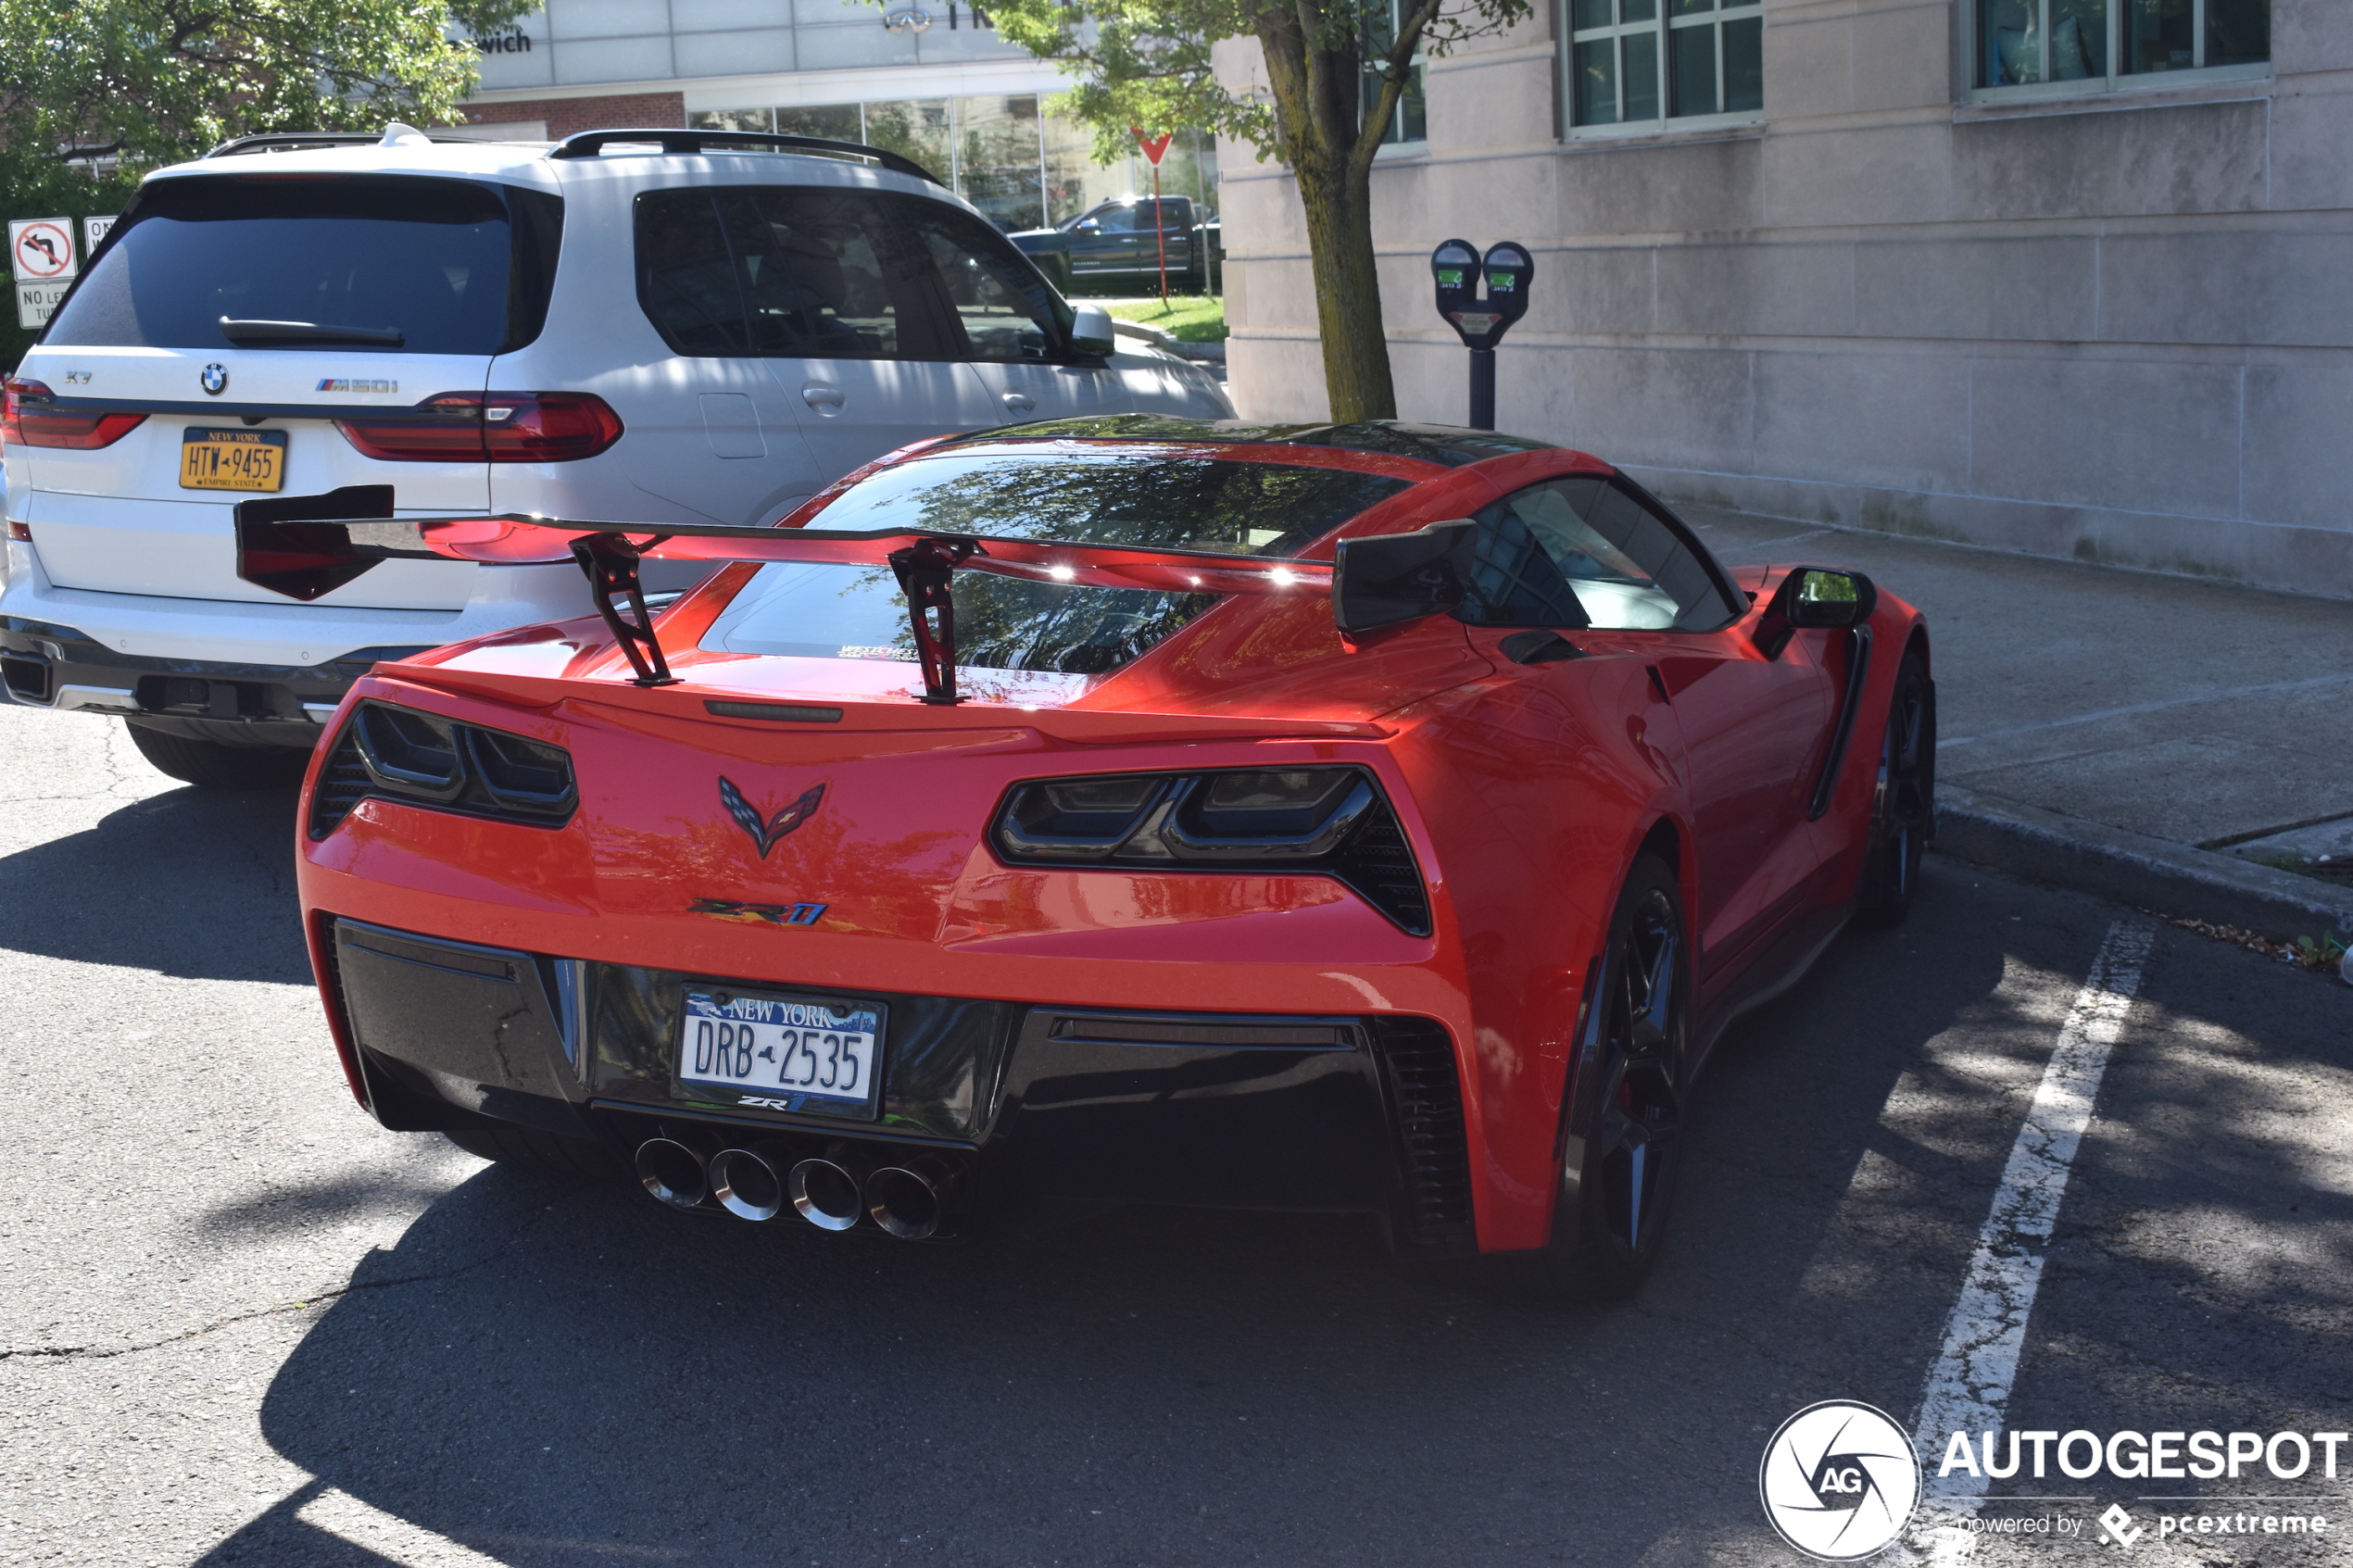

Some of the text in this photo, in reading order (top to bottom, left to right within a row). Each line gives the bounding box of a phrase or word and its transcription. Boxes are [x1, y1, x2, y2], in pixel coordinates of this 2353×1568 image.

[23, 291, 42, 305] NO
[65, 370, 93, 384] X7
[208, 432, 261, 443] NEW YORK
[205, 478, 257, 488] EMPIRE STATE
[686, 898, 828, 925] ZR1
[729, 997, 833, 1028] NEW YORK
[737, 1095, 807, 1111] ZR1
